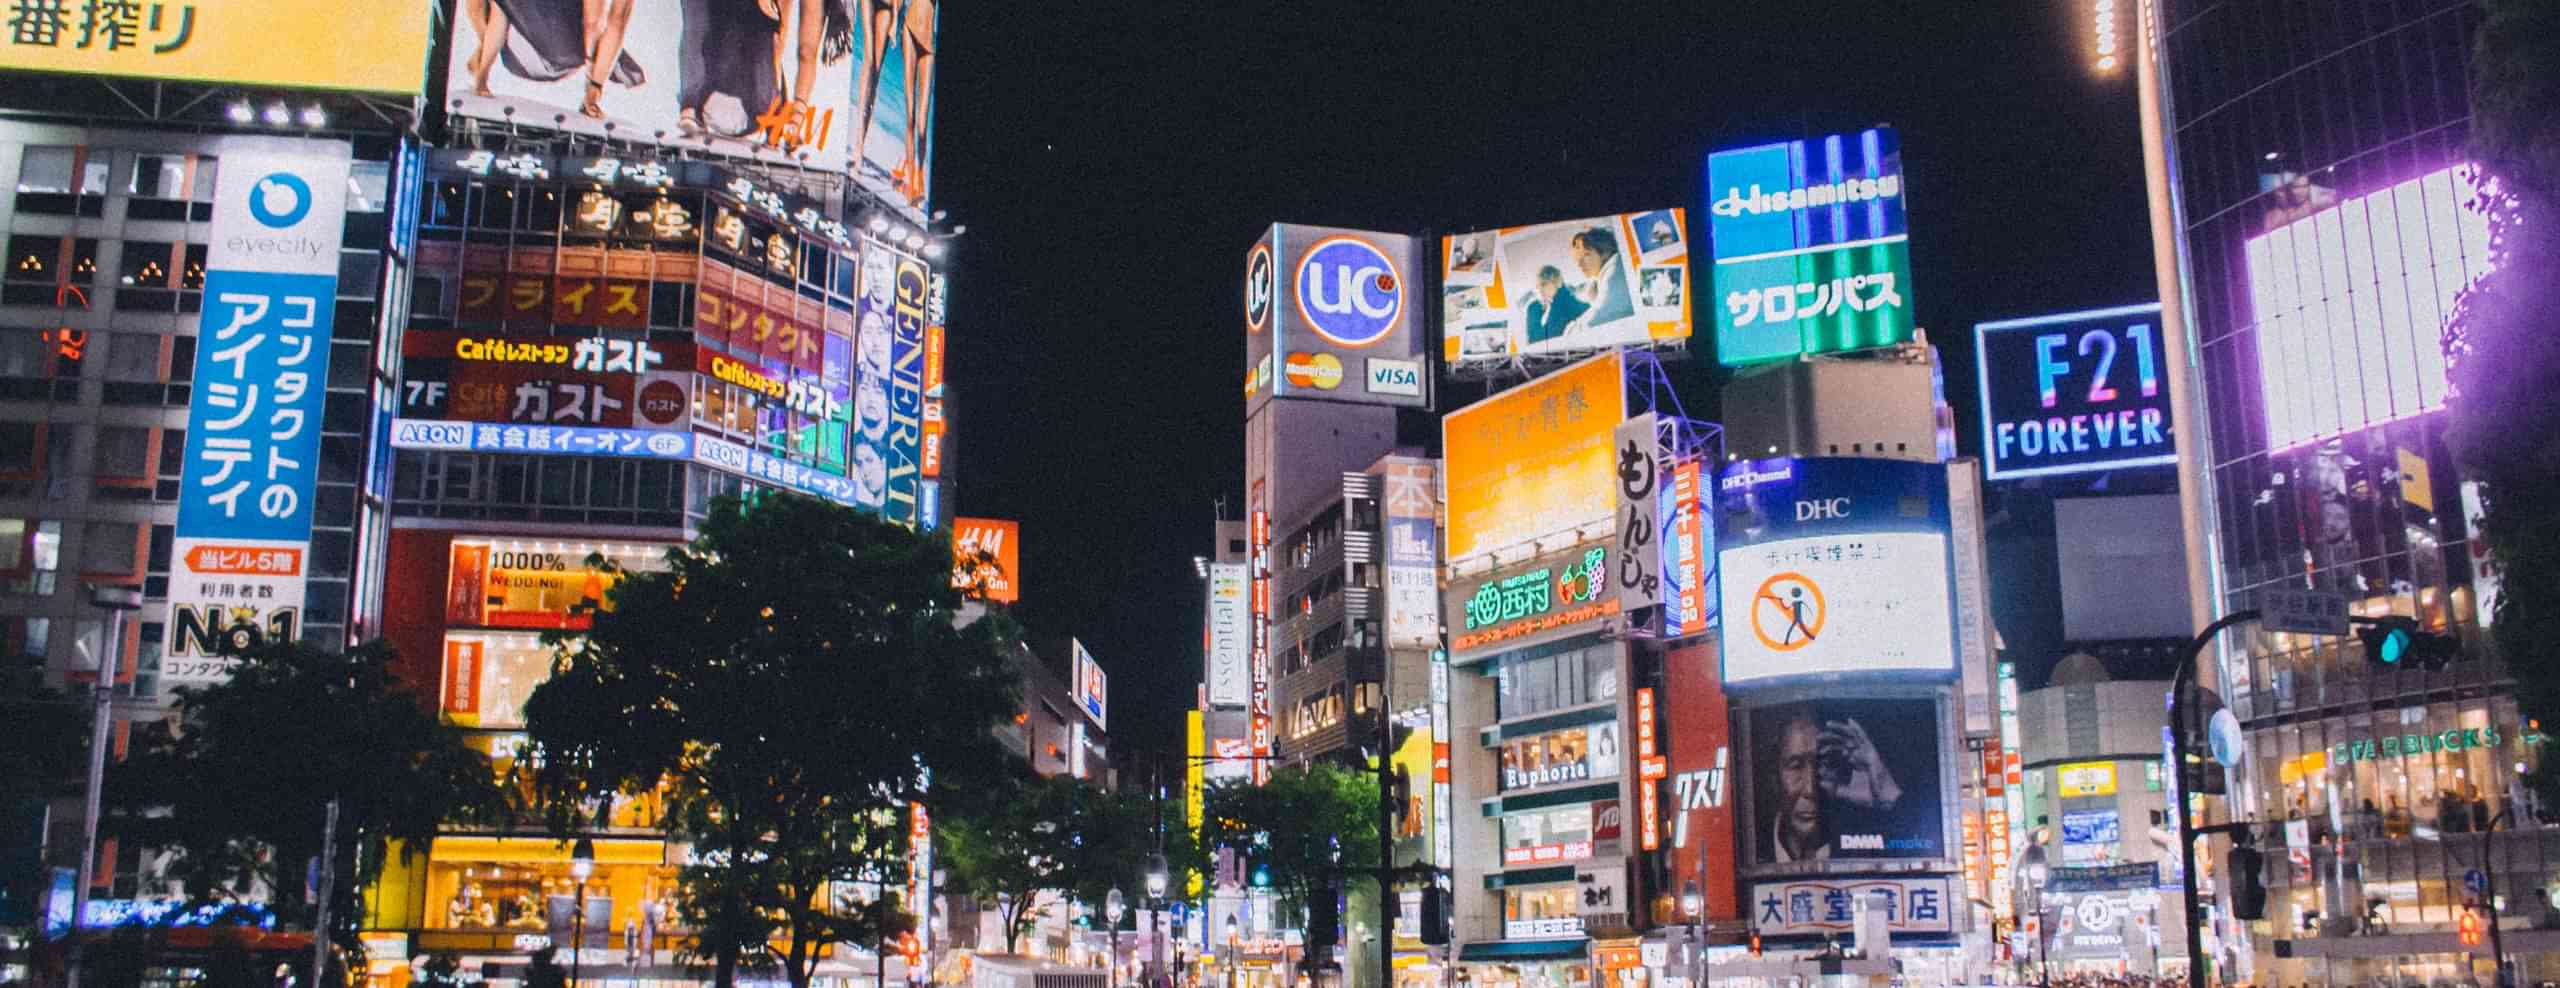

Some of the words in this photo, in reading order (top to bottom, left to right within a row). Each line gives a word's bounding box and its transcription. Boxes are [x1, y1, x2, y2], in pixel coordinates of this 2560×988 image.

[1712, 174, 1899, 218] Hisamitsu
[227, 236, 324, 258] eyecity
[1727, 272, 1901, 327] サロンパス
[573, 337, 663, 373] ガスト
[2036, 323, 2158, 409] F21
[405, 380, 447, 407] 7F
[1375, 368, 1417, 386] VISA
[201, 293, 270, 518] アイシティ
[261, 296, 317, 520] コンタクトの
[512, 380, 623, 423] ガスト
[786, 378, 842, 421] ガスト
[400, 424, 464, 444] AEON
[477, 425, 642, 452] 英会話イーオン
[700, 438, 744, 466] AEON
[1997, 408, 2163, 460] FOREVER
[1618, 440, 1658, 600] もんじゃ
[1795, 497, 1850, 522] DHC
[957, 527, 1005, 559] HM
[200, 553, 293, 573] 当ビル5階
[492, 552, 566, 572] 1000%
[200, 583, 274, 599] 利用者数
[1502, 580, 1550, 621] 西村
[2335, 727, 2500, 765] STARBUCKS
[1507, 761, 1587, 789] Euphoria
